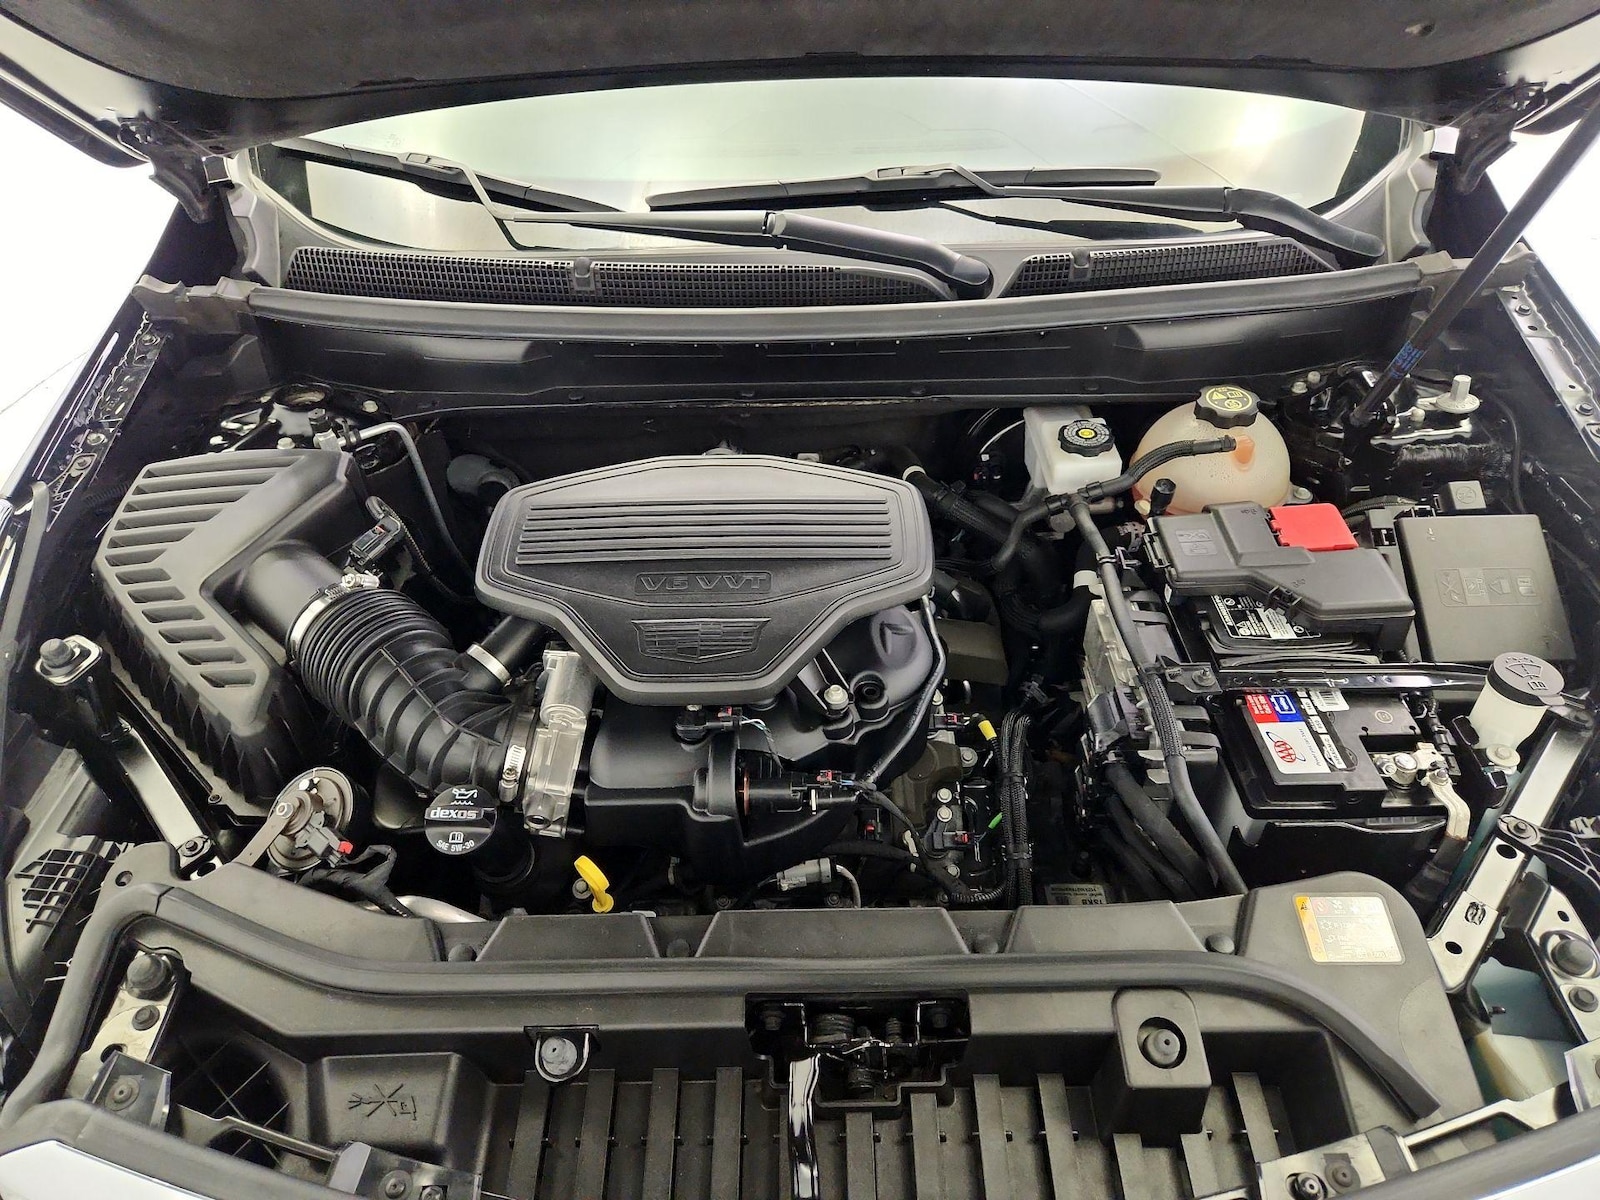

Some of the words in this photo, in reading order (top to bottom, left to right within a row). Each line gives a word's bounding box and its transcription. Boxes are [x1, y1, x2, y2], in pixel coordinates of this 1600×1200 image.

[640, 576, 689, 590] V6
[696, 574, 767, 589] VVT
[1275, 742, 1296, 762] AAA
[430, 807, 479, 819] dexos
[436, 839, 450, 851] SAE
[450, 839, 475, 852] 5W-30
